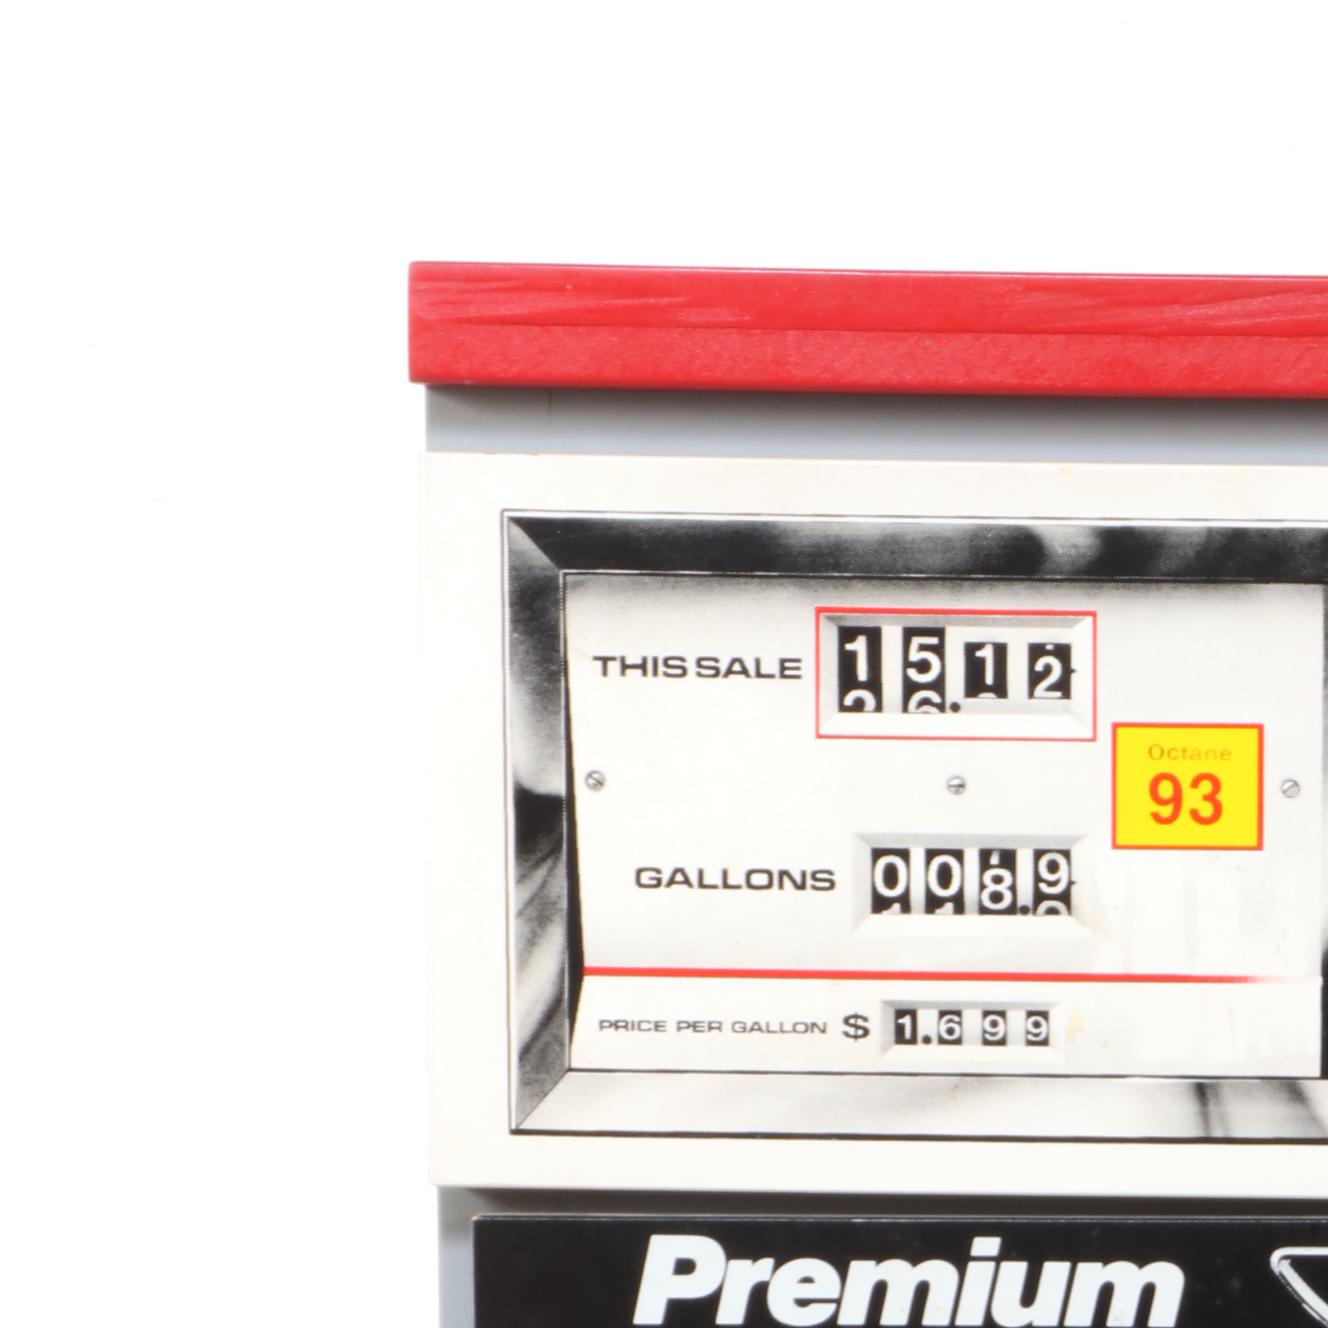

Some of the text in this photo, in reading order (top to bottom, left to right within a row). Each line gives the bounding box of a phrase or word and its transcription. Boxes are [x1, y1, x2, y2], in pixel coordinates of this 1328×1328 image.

[593, 655, 803, 681] THIS SALE
[1148, 743, 1233, 763] Octane
[1148, 771, 1224, 826] 93
[634, 866, 836, 892] GALLONS
[598, 1018, 668, 1033] PRICE
[675, 1019, 724, 1033] PER
[730, 1020, 828, 1035] GALLON
